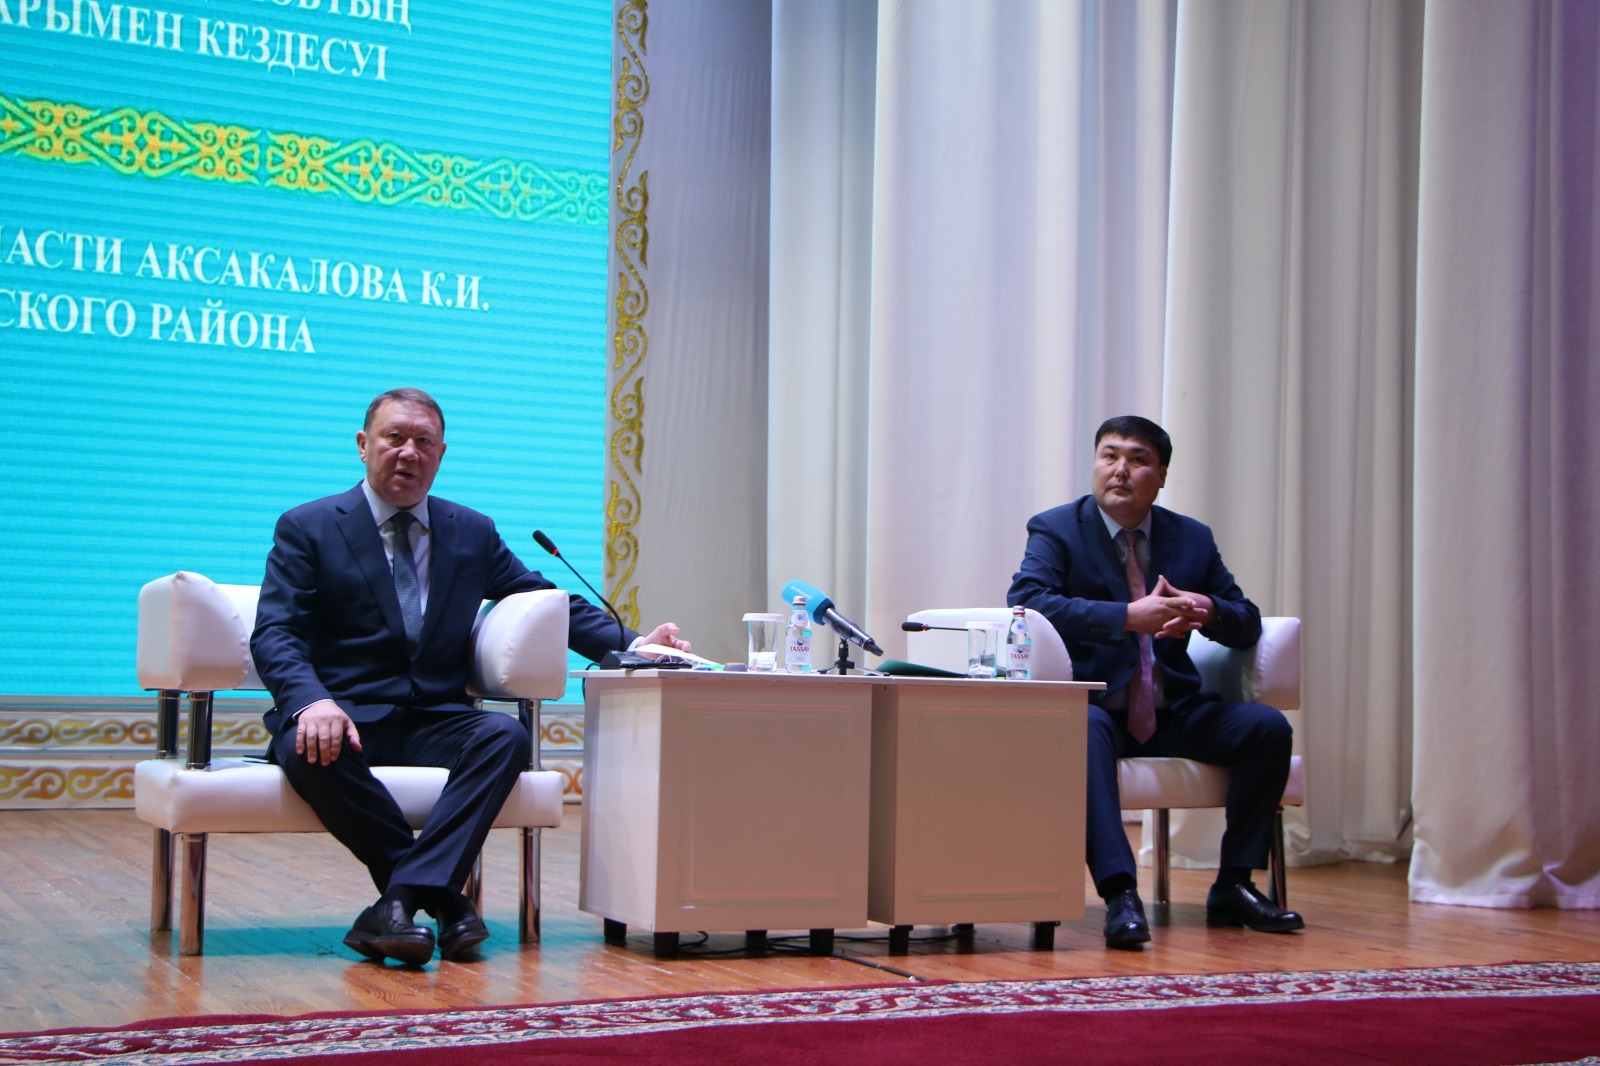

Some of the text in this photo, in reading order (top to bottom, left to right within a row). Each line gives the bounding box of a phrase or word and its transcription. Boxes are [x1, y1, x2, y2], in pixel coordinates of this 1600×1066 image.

[196, 18, 390, 81] КЕЗДЕСУІ
[0, 224, 490, 312] АСТИ АКСАКАЛОВА К.И.
[150, 298, 316, 354] РАЙОНА
